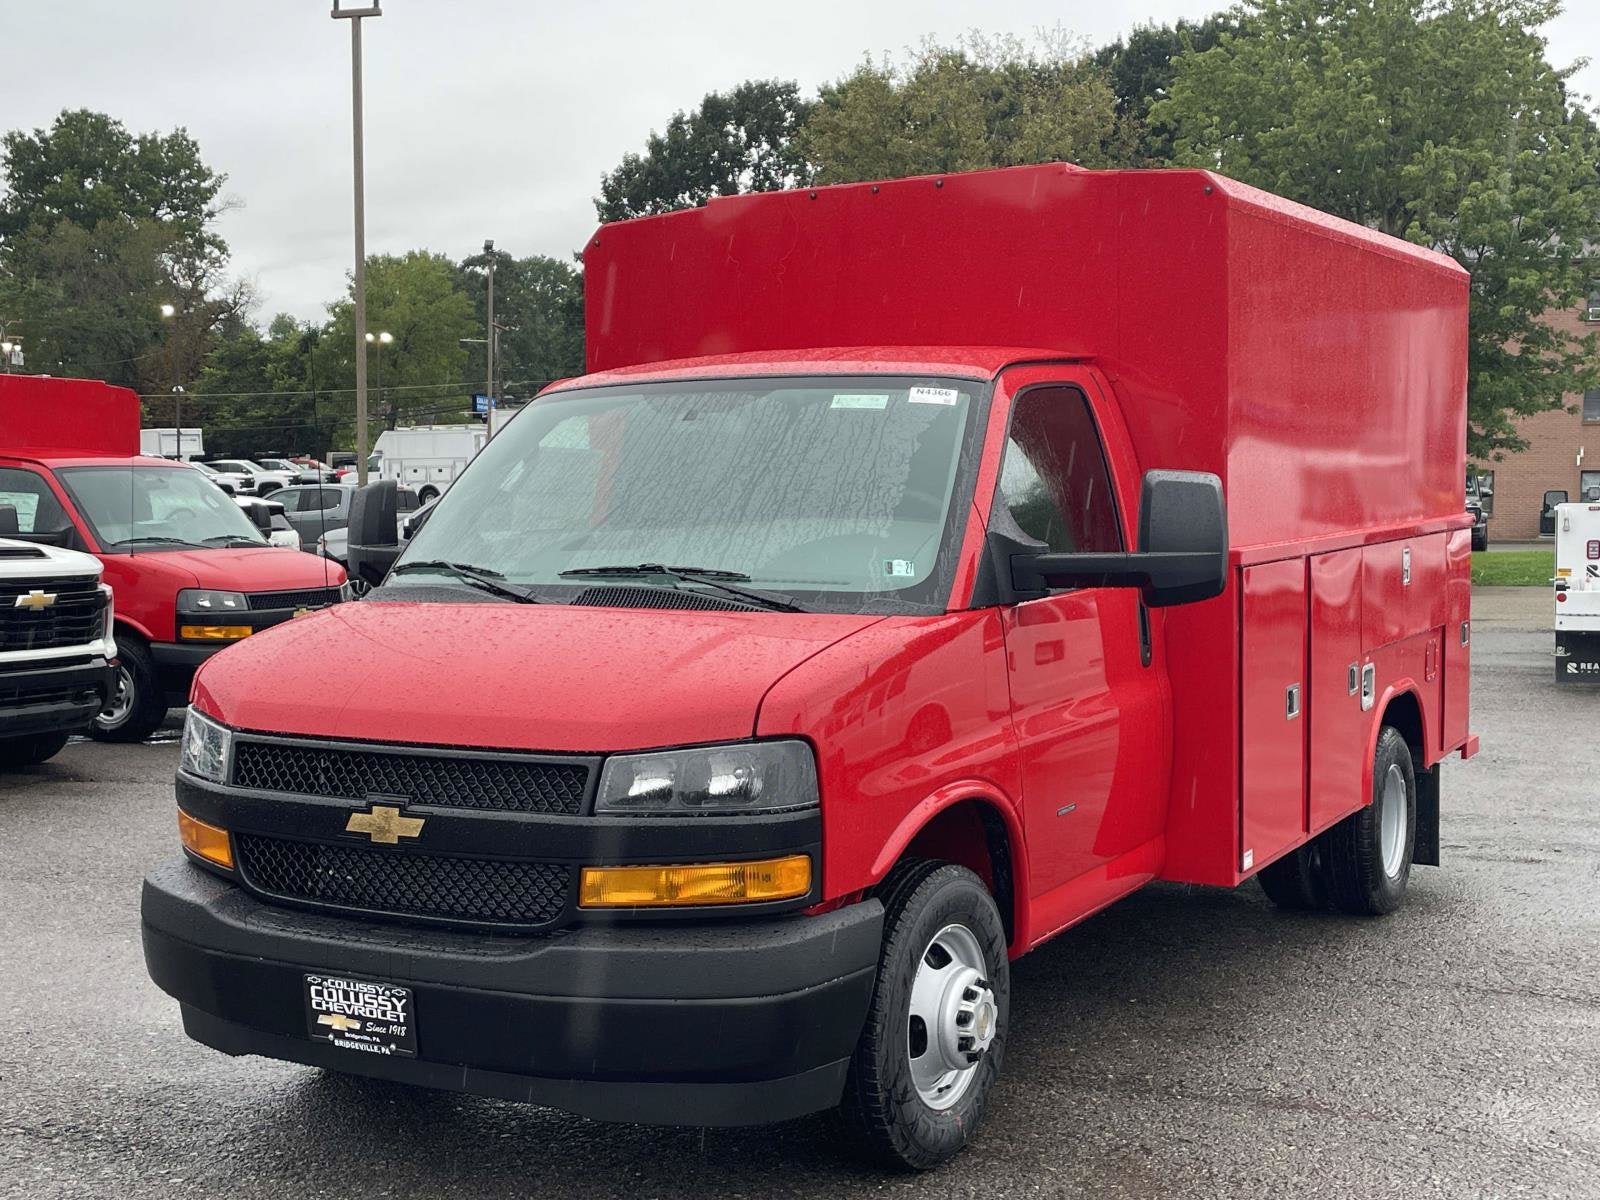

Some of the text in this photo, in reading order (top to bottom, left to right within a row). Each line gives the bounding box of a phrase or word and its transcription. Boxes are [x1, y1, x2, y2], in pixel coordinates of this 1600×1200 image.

[328, 979, 386, 995] COLUSSY
[310, 985, 407, 1012] COLUSSY
[311, 999, 407, 1023] CHEVROLET
[365, 1022, 407, 1037] Since 1918
[334, 1038, 391, 1055] BRIDGEVILLE, PA
